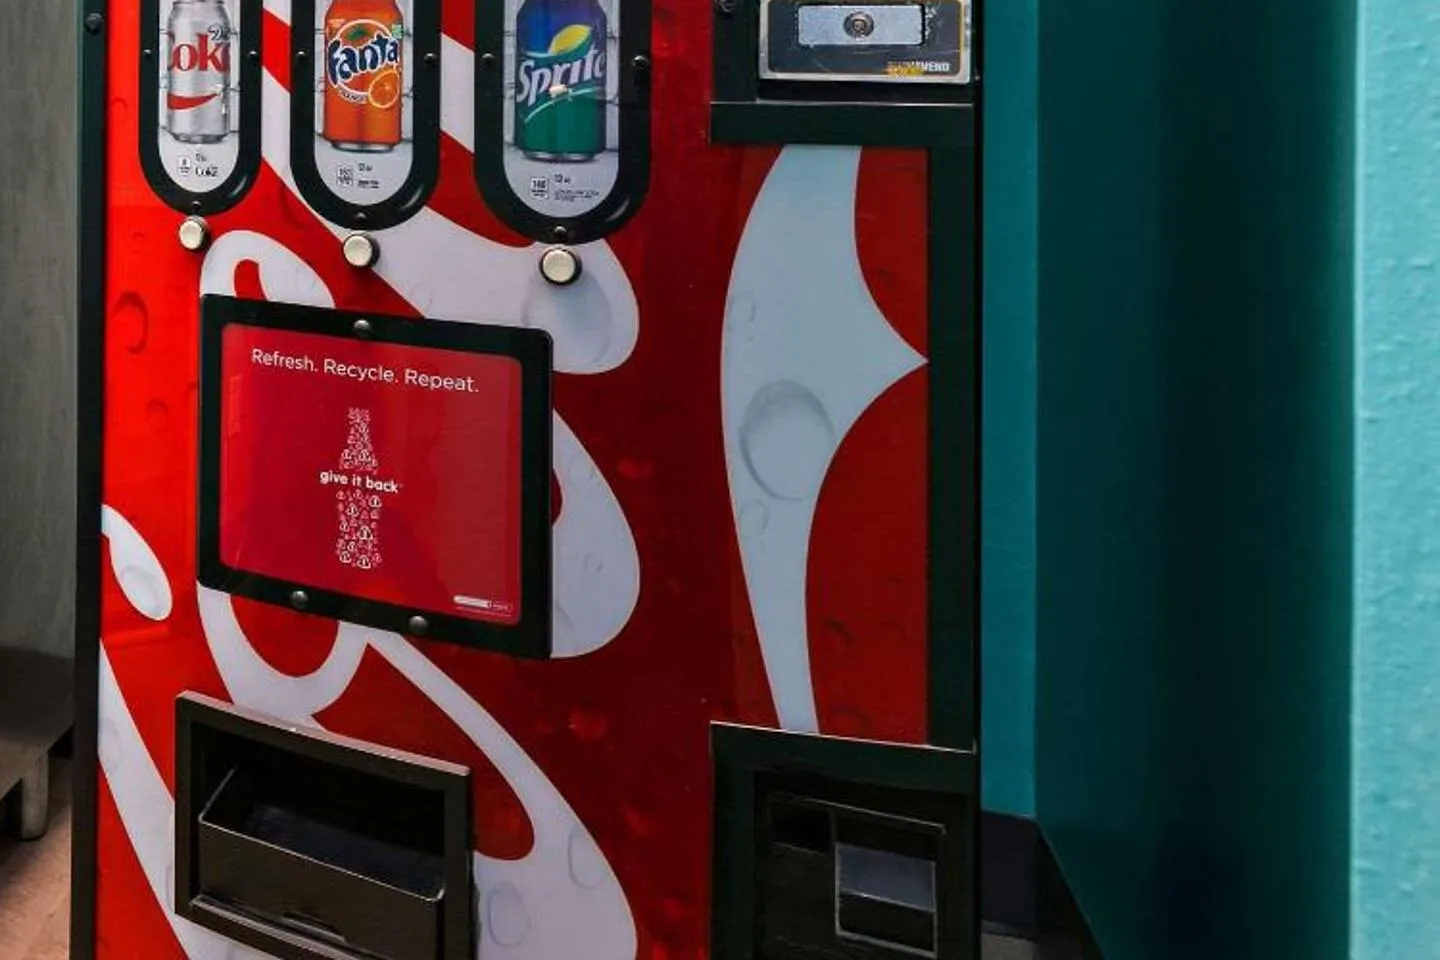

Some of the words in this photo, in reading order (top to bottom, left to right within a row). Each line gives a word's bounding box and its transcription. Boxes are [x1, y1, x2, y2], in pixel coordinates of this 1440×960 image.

[516, 48, 606, 107] Sprite
[251, 348, 318, 373] Refresh.
[323, 359, 399, 384] Recycle.
[404, 369, 479, 393] Repeat.
[319, 470, 349, 487] give
[352, 474, 362, 488] it
[365, 477, 399, 493] back
